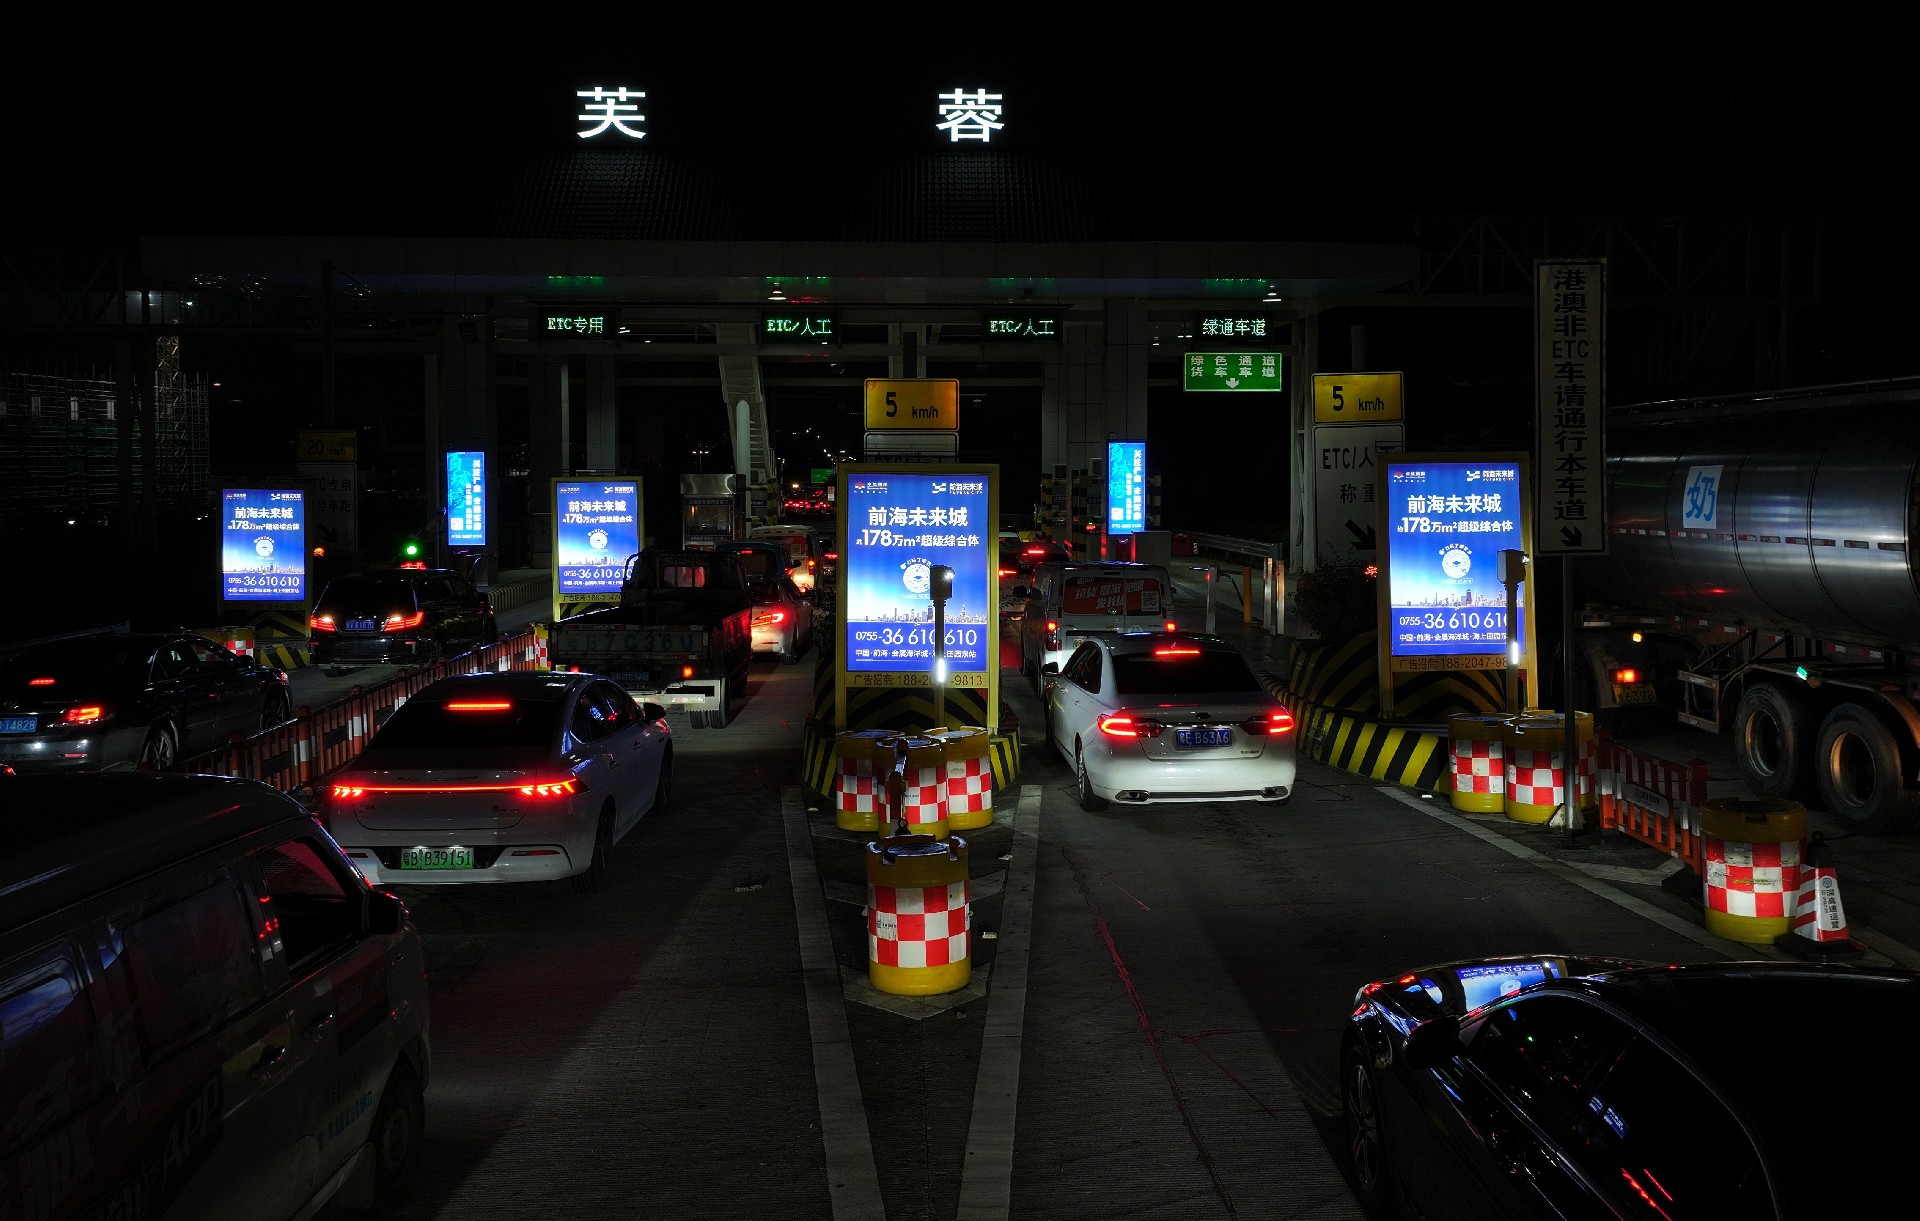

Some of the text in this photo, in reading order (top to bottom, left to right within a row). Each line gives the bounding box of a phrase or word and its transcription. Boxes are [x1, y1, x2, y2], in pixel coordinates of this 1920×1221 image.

[577, 87, 1005, 142] 芙 蓉
[547, 317, 604, 333] ETC专用
[767, 318, 832, 335] ETC/人工
[989, 318, 1054, 336] ETC/人工
[1202, 318, 1267, 336] 绿通车道
[1190, 355, 1276, 366] 绿色通道
[1190, 366, 1276, 378] 货车车道
[1332, 385, 1384, 411] 5 km/h
[1552, 269, 1588, 521] 港澳非ETC车请通行本车道
[885, 391, 938, 419] 5 km/h
[307, 439, 324, 455] 20
[304, 477, 351, 491] TC专用
[1407, 493, 1502, 513] 前海未来城
[1685, 471, 1715, 521] 奶
[234, 506, 294, 519] 前海未来城
[311, 498, 351, 512] 持车距
[568, 500, 627, 512] 前海未来城
[868, 506, 968, 526] 前海未来城
[258, 576, 278, 586] 610
[279, 576, 300, 586] 610
[593, 568, 612, 579] 610
[1399, 612, 1507, 629] 0755-36 610 61
[855, 628, 904, 645] 0755-36
[944, 629, 977, 646] 610
